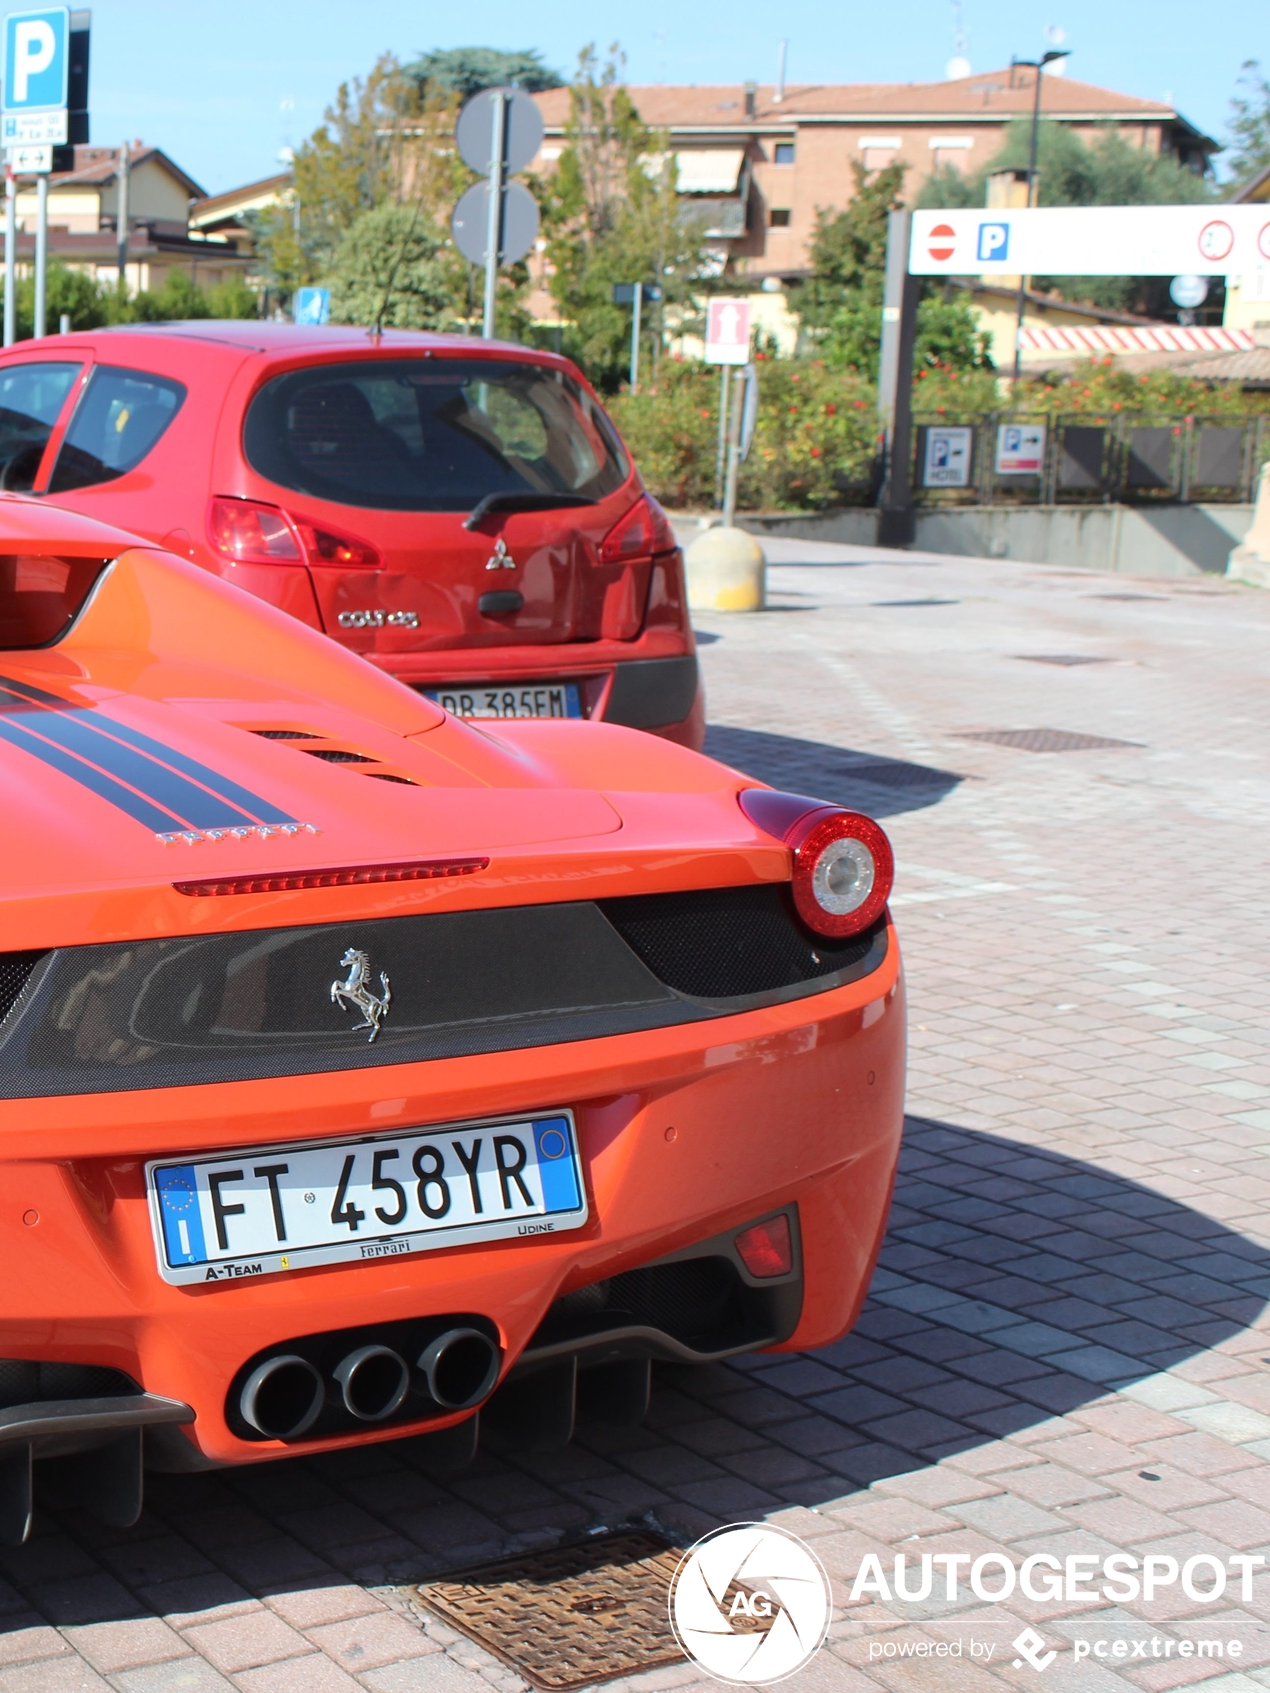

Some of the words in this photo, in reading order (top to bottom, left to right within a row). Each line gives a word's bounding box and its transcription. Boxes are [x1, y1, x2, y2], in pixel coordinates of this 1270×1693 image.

[13, 19, 56, 103] P
[980, 224, 1005, 259] P
[338, 609, 386, 629] COLT
[207, 1163, 289, 1250] FT
[330, 1135, 536, 1231] 458YR
[360, 1239, 411, 1259] Ferrari
